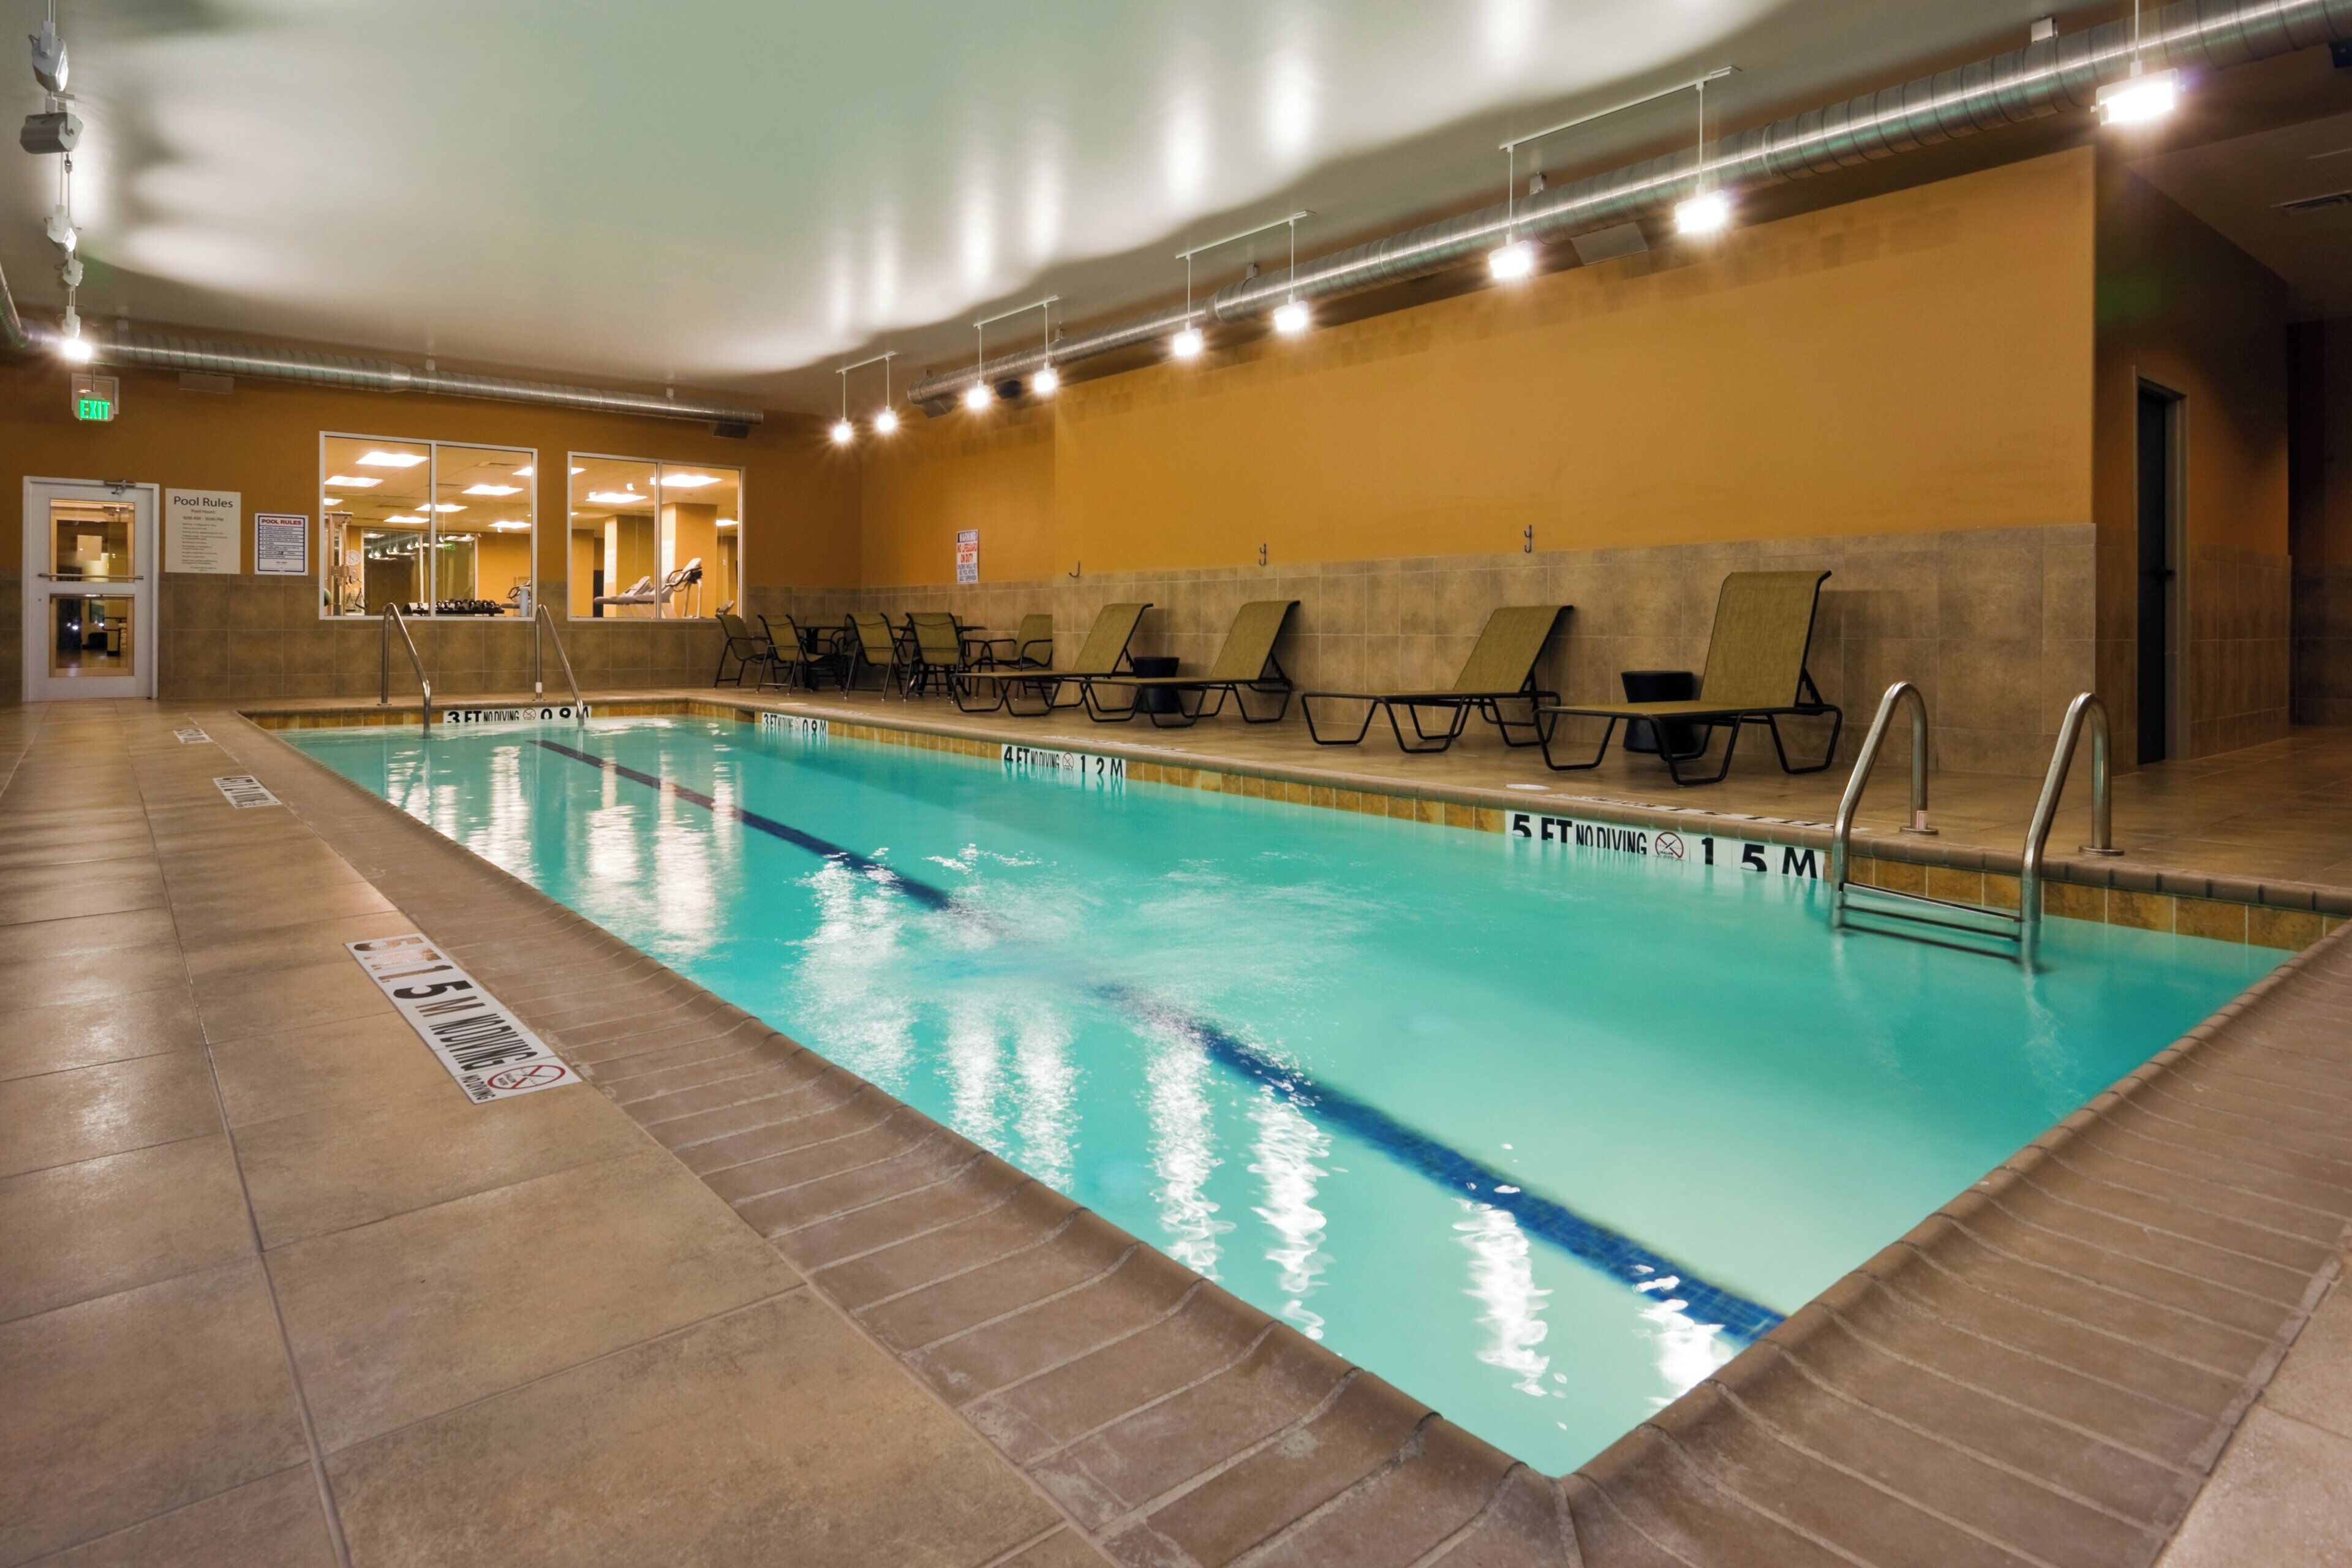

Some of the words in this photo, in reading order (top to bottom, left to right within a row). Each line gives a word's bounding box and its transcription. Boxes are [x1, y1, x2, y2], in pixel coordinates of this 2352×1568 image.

[80, 399, 110, 420] EXIT
[174, 496, 199, 506] Pool
[203, 497, 233, 508] Rules
[447, 710, 460, 723] 3
[464, 710, 482, 723] FT
[483, 711, 493, 722] NO
[494, 710, 519, 722] DIVING
[764, 714, 768, 725] 3
[771, 714, 777, 726] FT
[820, 720, 826, 734] M
[1004, 746, 1013, 761] 4
[1017, 747, 1030, 764] FT
[1031, 750, 1038, 766] NO
[1039, 752, 1060, 768] DIVING
[1080, 755, 1085, 772] 1
[1096, 757, 1104, 774] 2
[1110, 758, 1123, 777] M
[1512, 813, 1532, 838] 5
[1541, 817, 1572, 843] FT
[1576, 824, 1593, 847] NO
[1597, 827, 1647, 855] DIVING
[1702, 837, 1714, 865] 1
[1740, 843, 1767, 872] 5
[1782, 846, 1817, 879] M
[415, 995, 486, 1017] M
[428, 1013, 506, 1035] NO
[440, 1025, 538, 1071] DIVING
[461, 1074, 481, 1084] NO
[466, 1081, 496, 1101] DIVING
